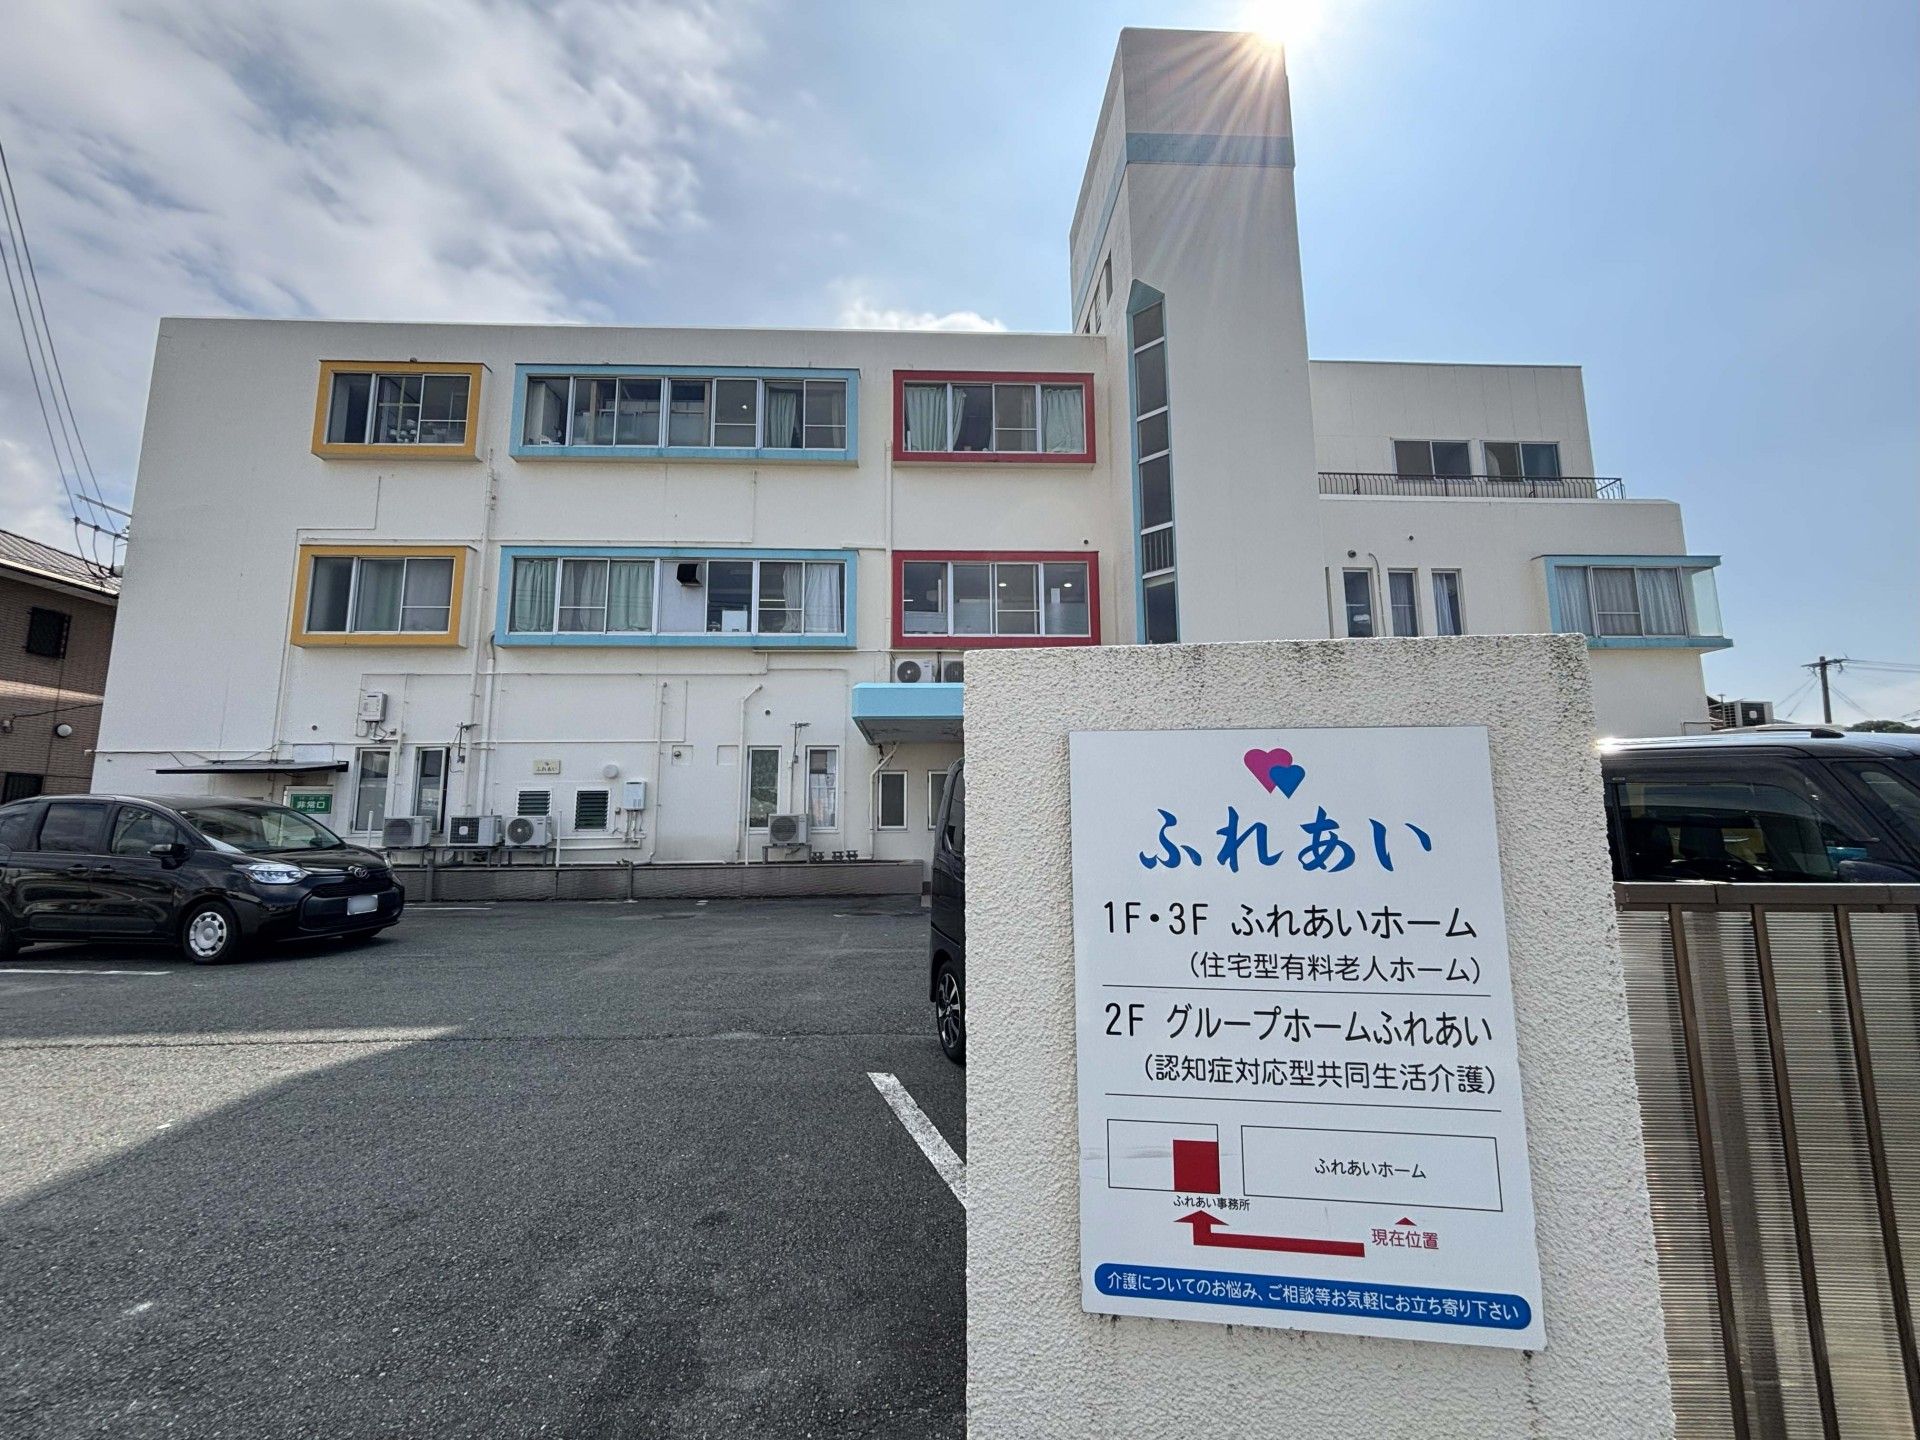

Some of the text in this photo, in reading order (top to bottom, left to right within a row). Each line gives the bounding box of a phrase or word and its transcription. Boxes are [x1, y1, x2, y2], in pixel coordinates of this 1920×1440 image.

[297, 800, 326, 809] 非常口
[1139, 805, 1432, 873] ふれあい
[1231, 904, 1478, 940] ふれあいホーム
[1190, 951, 1482, 985] （住宅型有料老人ホーム）
[1105, 1002, 1493, 1049] 2F グループホームふれあい
[1144, 1054, 1496, 1095] （認知症対応型共同生活介護）
[1314, 1158, 1427, 1179] ふれあいホーム
[1172, 1195, 1251, 1212] ふれあい事務所
[1371, 1228, 1440, 1250] 現在位置
[1107, 1271, 1520, 1321] 介護についてのお悩み、ご相談等お気軽にお立ち寄り下さい
